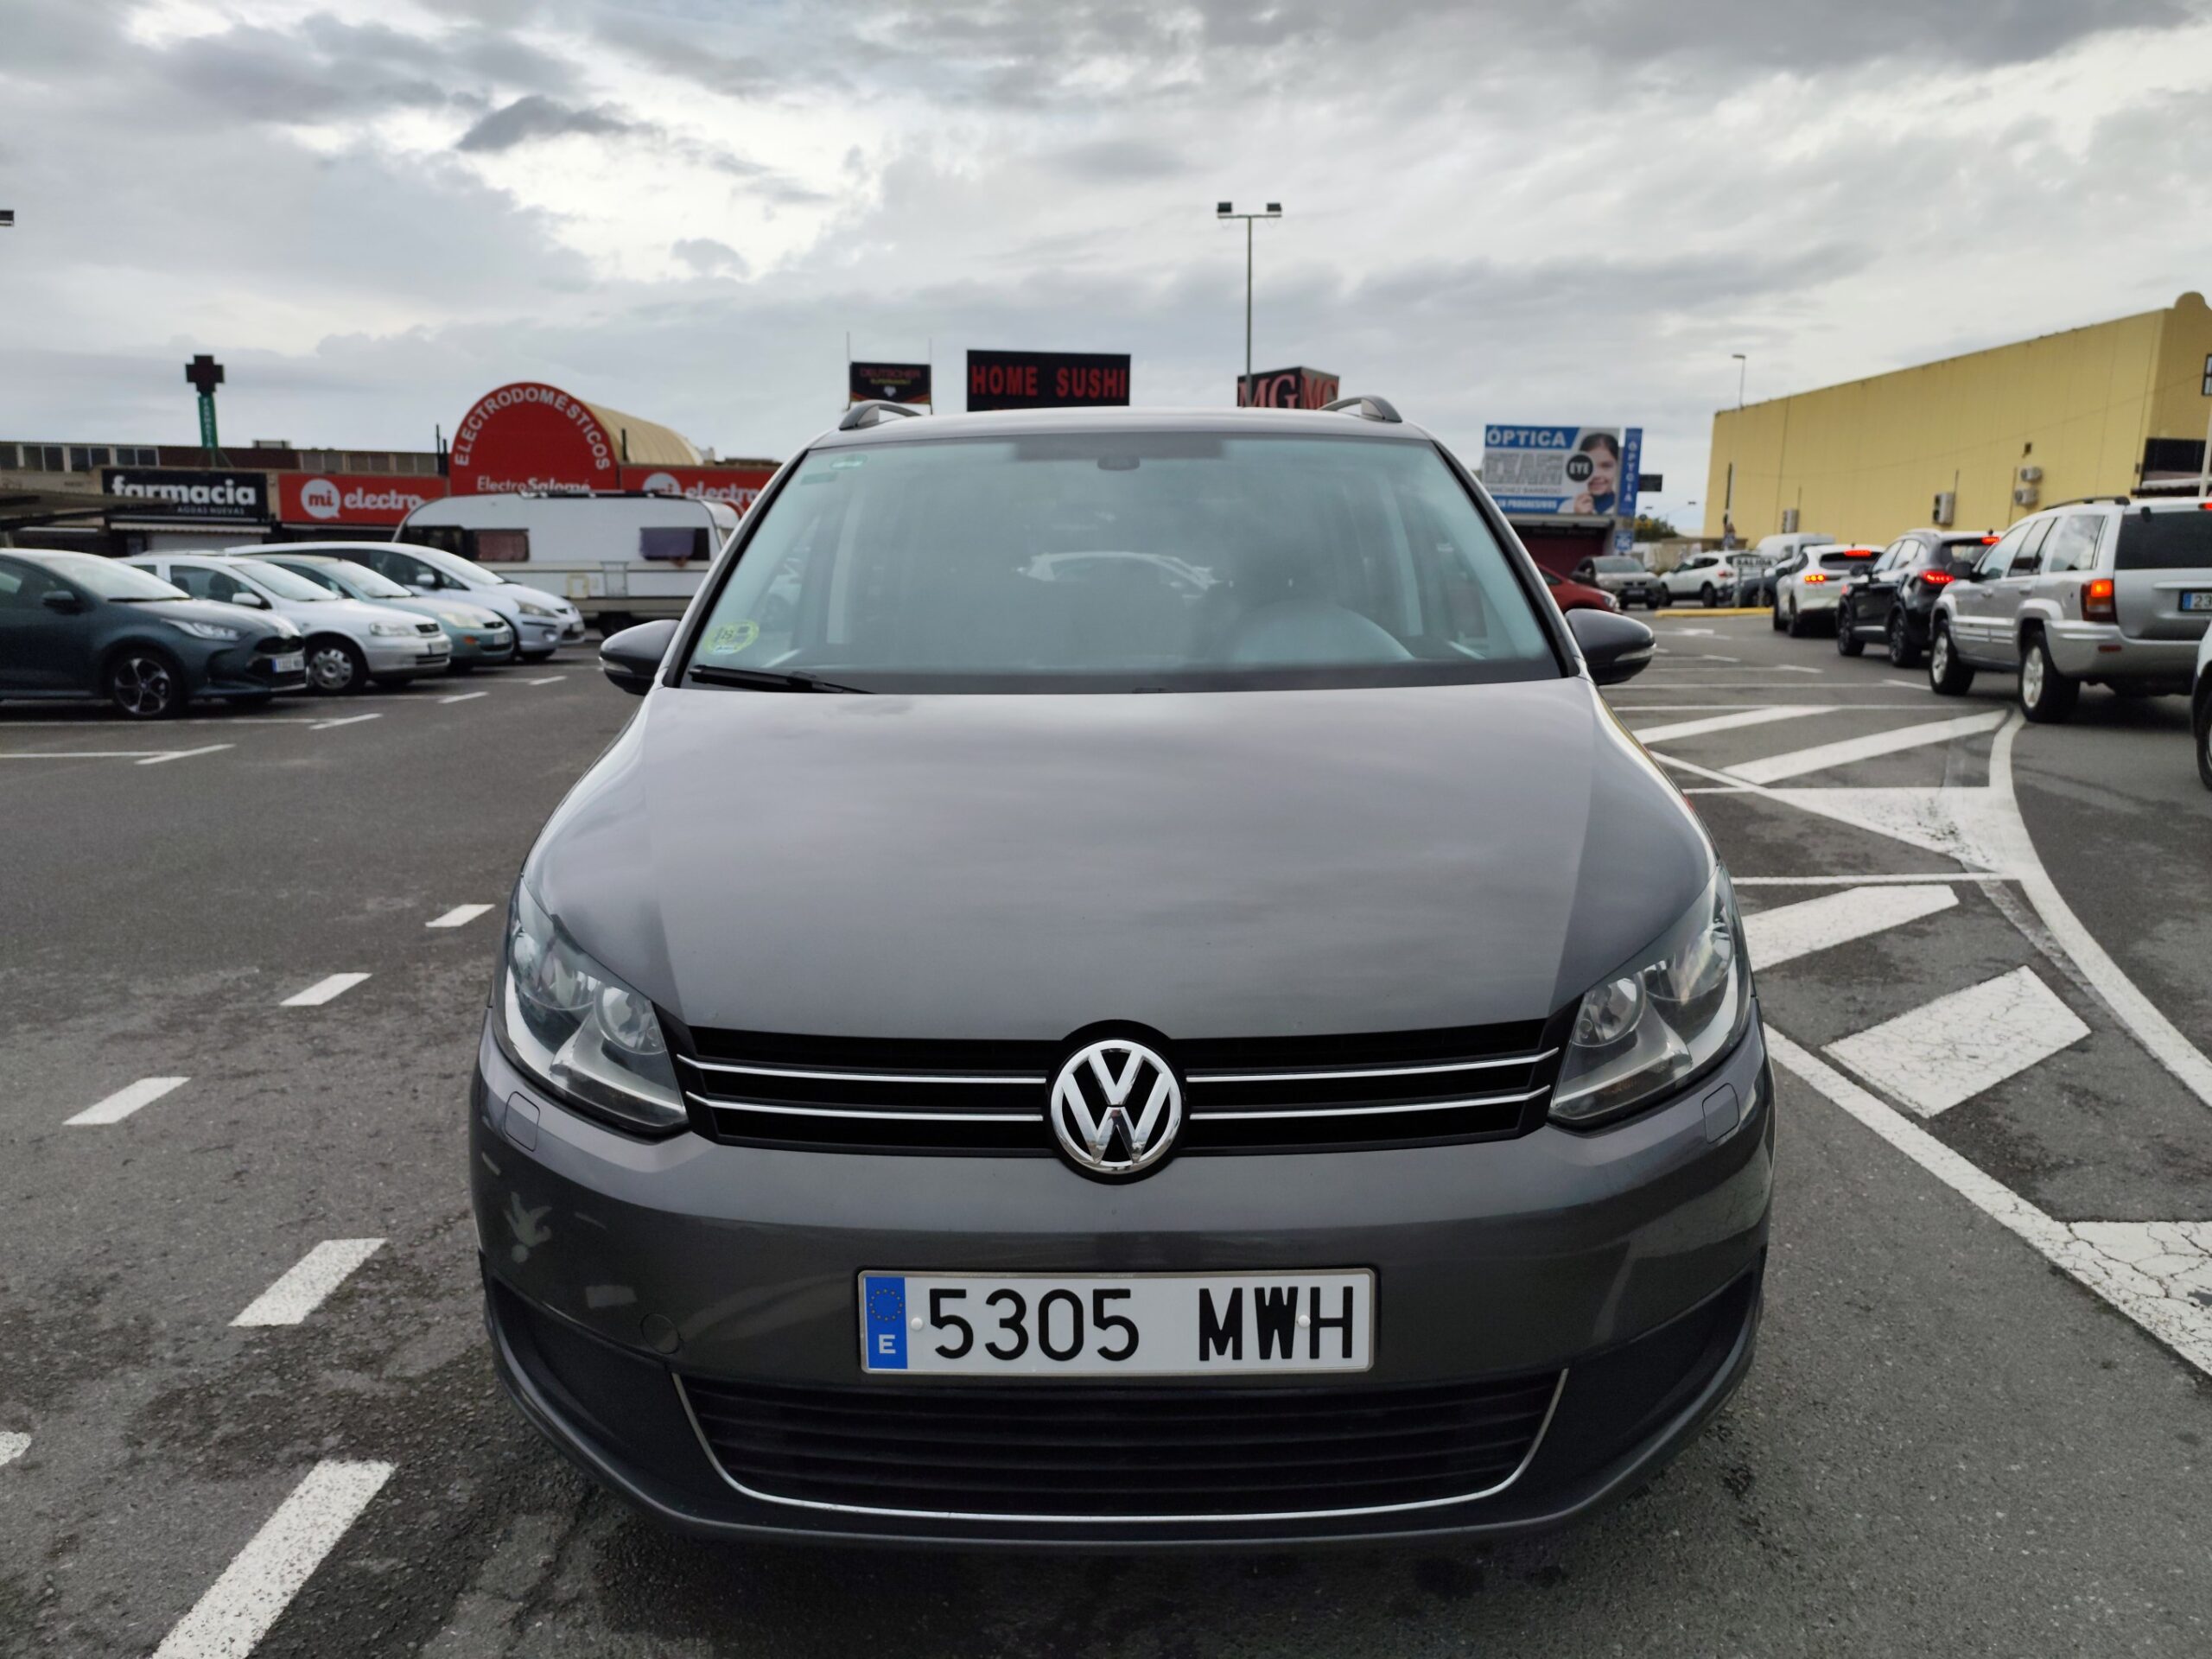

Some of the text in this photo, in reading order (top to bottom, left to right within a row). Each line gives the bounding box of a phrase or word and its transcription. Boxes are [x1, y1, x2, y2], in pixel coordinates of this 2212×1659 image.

[970, 365, 1126, 398] HOME SUSHI
[454, 387, 610, 470] ELECTRODOMÉSTICOS
[1486, 427, 1567, 447] ÓPTICA
[1569, 462, 1590, 474] EYE
[111, 476, 256, 505] farmacia
[308, 487, 423, 510] mi electro
[878, 1286, 1353, 1362] E 5305 MWH
